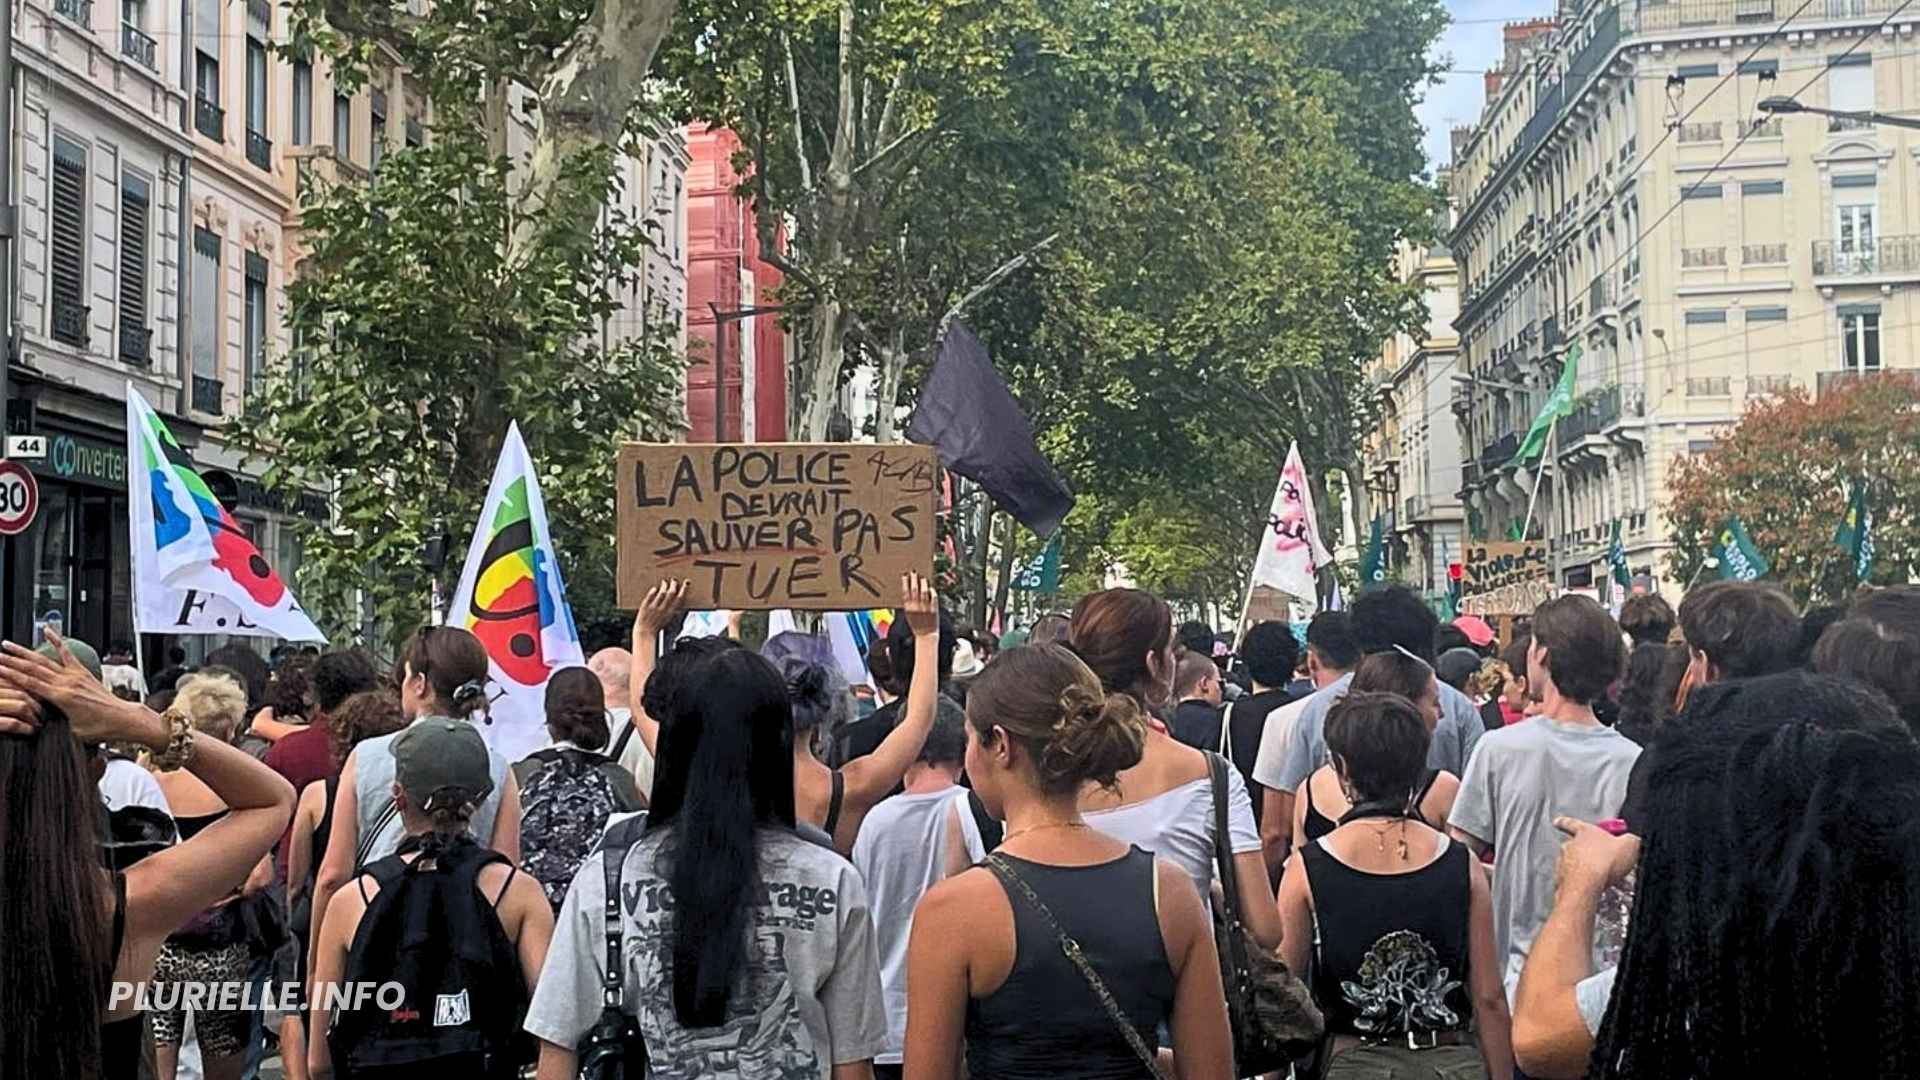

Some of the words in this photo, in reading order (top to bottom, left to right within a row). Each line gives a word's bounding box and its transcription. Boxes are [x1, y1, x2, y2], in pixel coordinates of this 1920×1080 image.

[17, 439, 40, 453] 44
[636, 455, 703, 508] LA
[713, 446, 852, 492] POLICE
[721, 488, 851, 522] DEVRAIT
[654, 517, 822, 557] SAUVER
[833, 506, 918, 555] PAS
[1465, 546, 1547, 582] Violence
[1467, 547, 1488, 564] La
[693, 555, 882, 604] TUER
